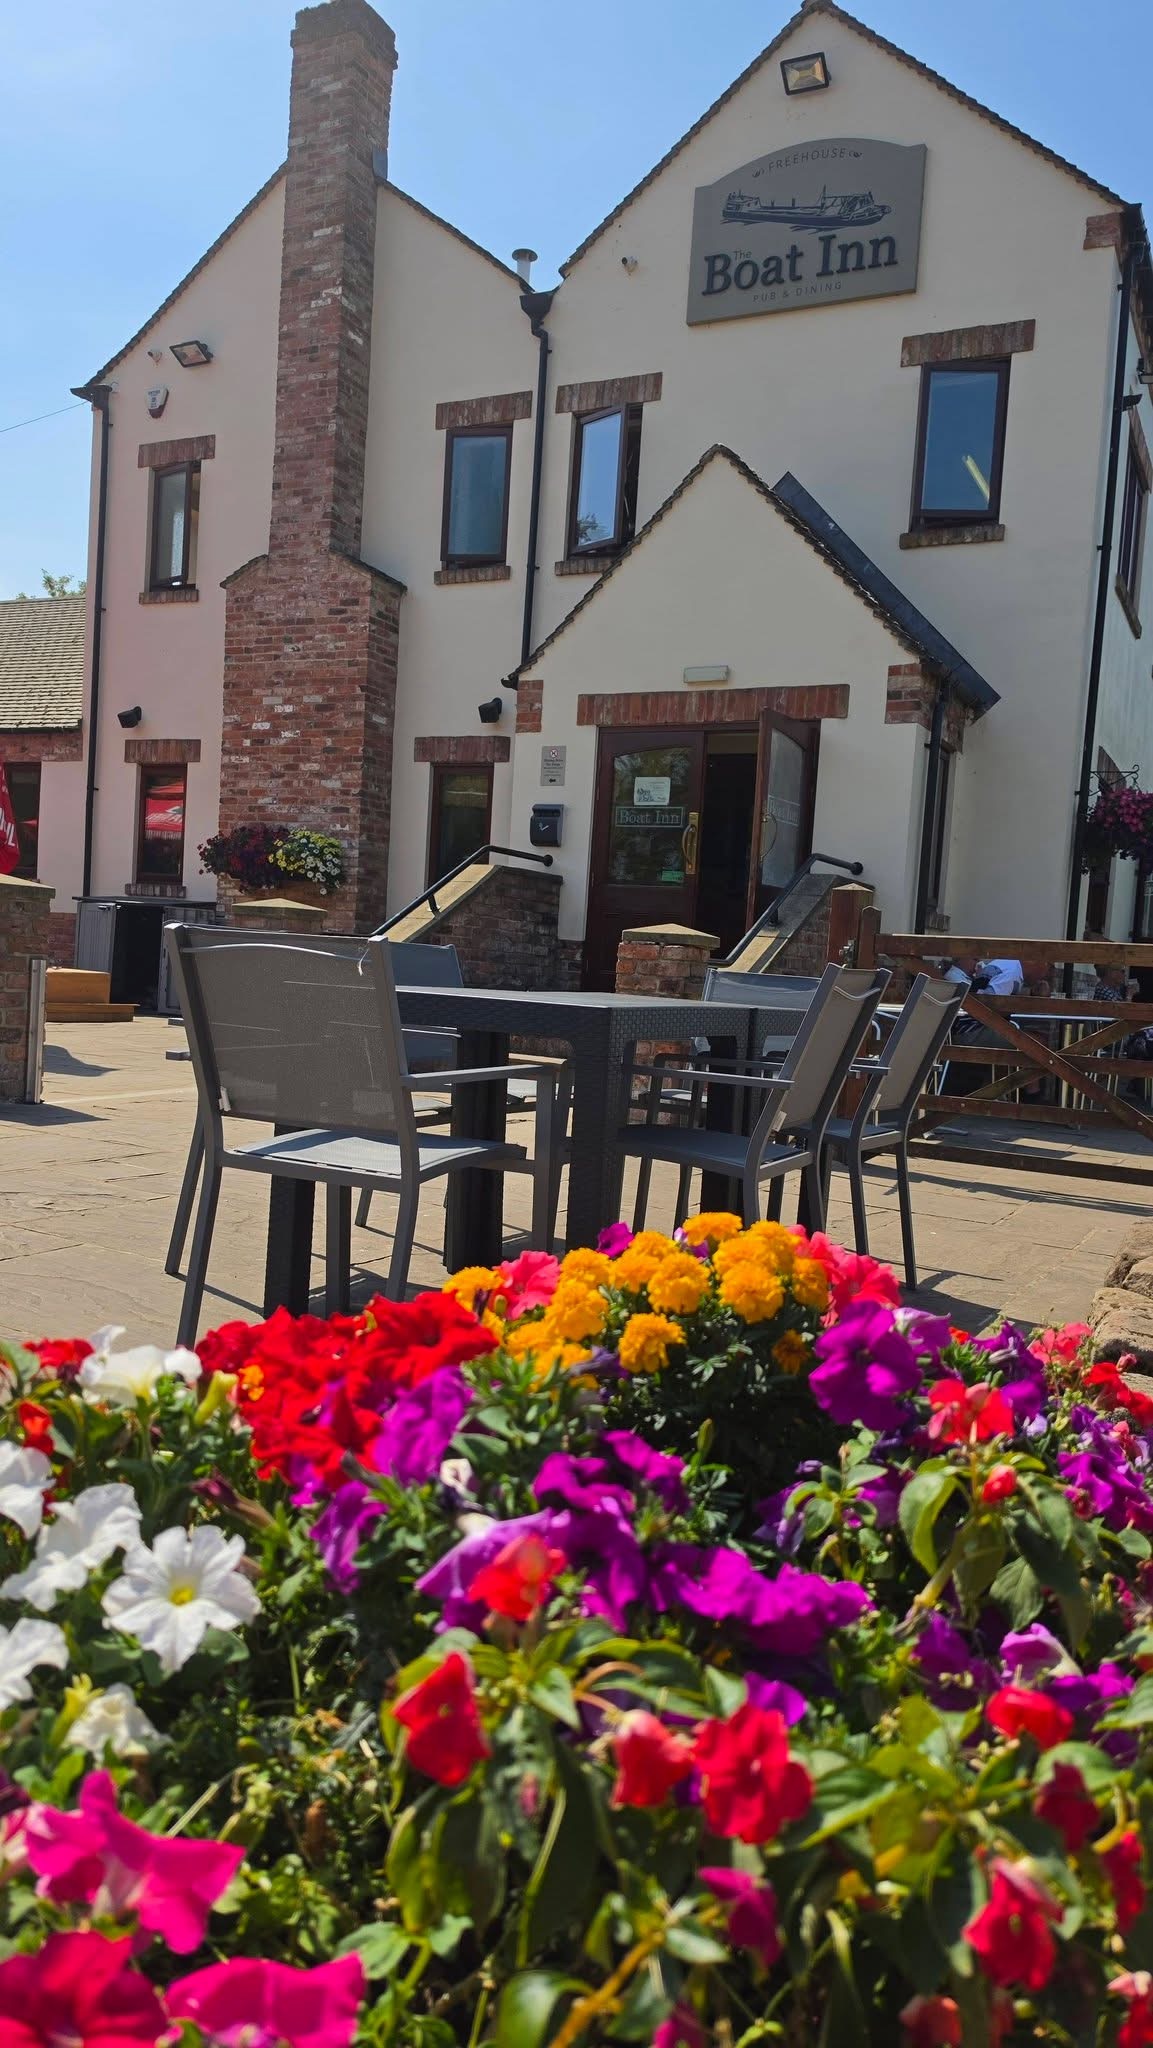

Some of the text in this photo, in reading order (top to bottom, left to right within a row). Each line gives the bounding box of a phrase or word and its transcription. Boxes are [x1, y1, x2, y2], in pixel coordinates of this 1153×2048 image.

[768, 147, 846, 172] FREEHOUSE
[702, 234, 898, 296] Boat Inn
[733, 250, 752, 261] The
[753, 281, 842, 302] PUB & DINING
[620, 809, 680, 824] Boat Inn
